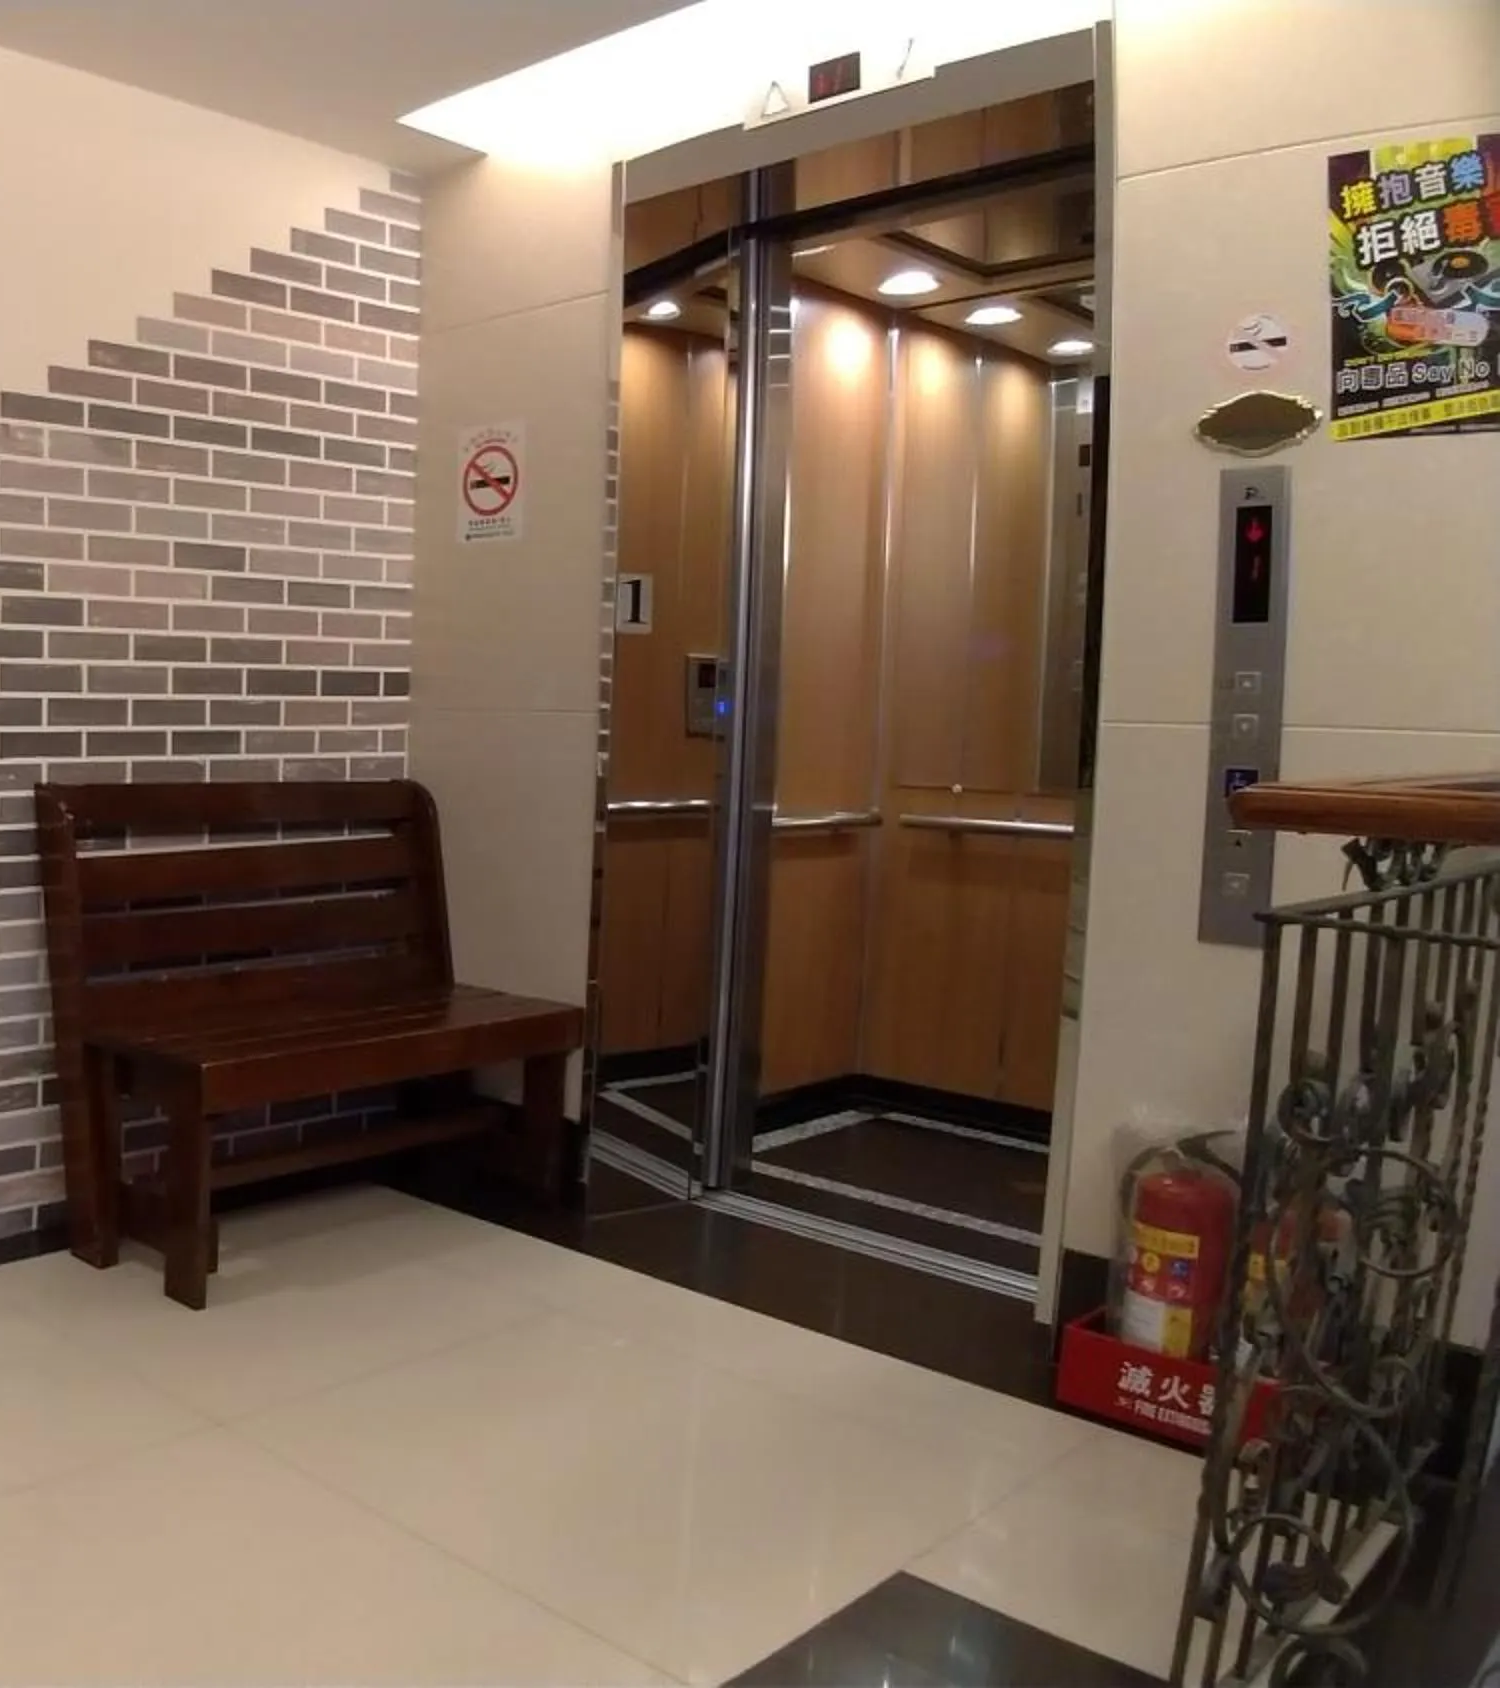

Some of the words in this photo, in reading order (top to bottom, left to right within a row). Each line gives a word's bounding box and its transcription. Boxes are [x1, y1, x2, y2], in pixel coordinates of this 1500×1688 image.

[1340, 153, 1484, 219] 擁抱音樂
[1411, 362, 1453, 384] Say
[1458, 357, 1490, 380] No
[620, 579, 648, 625] 1
